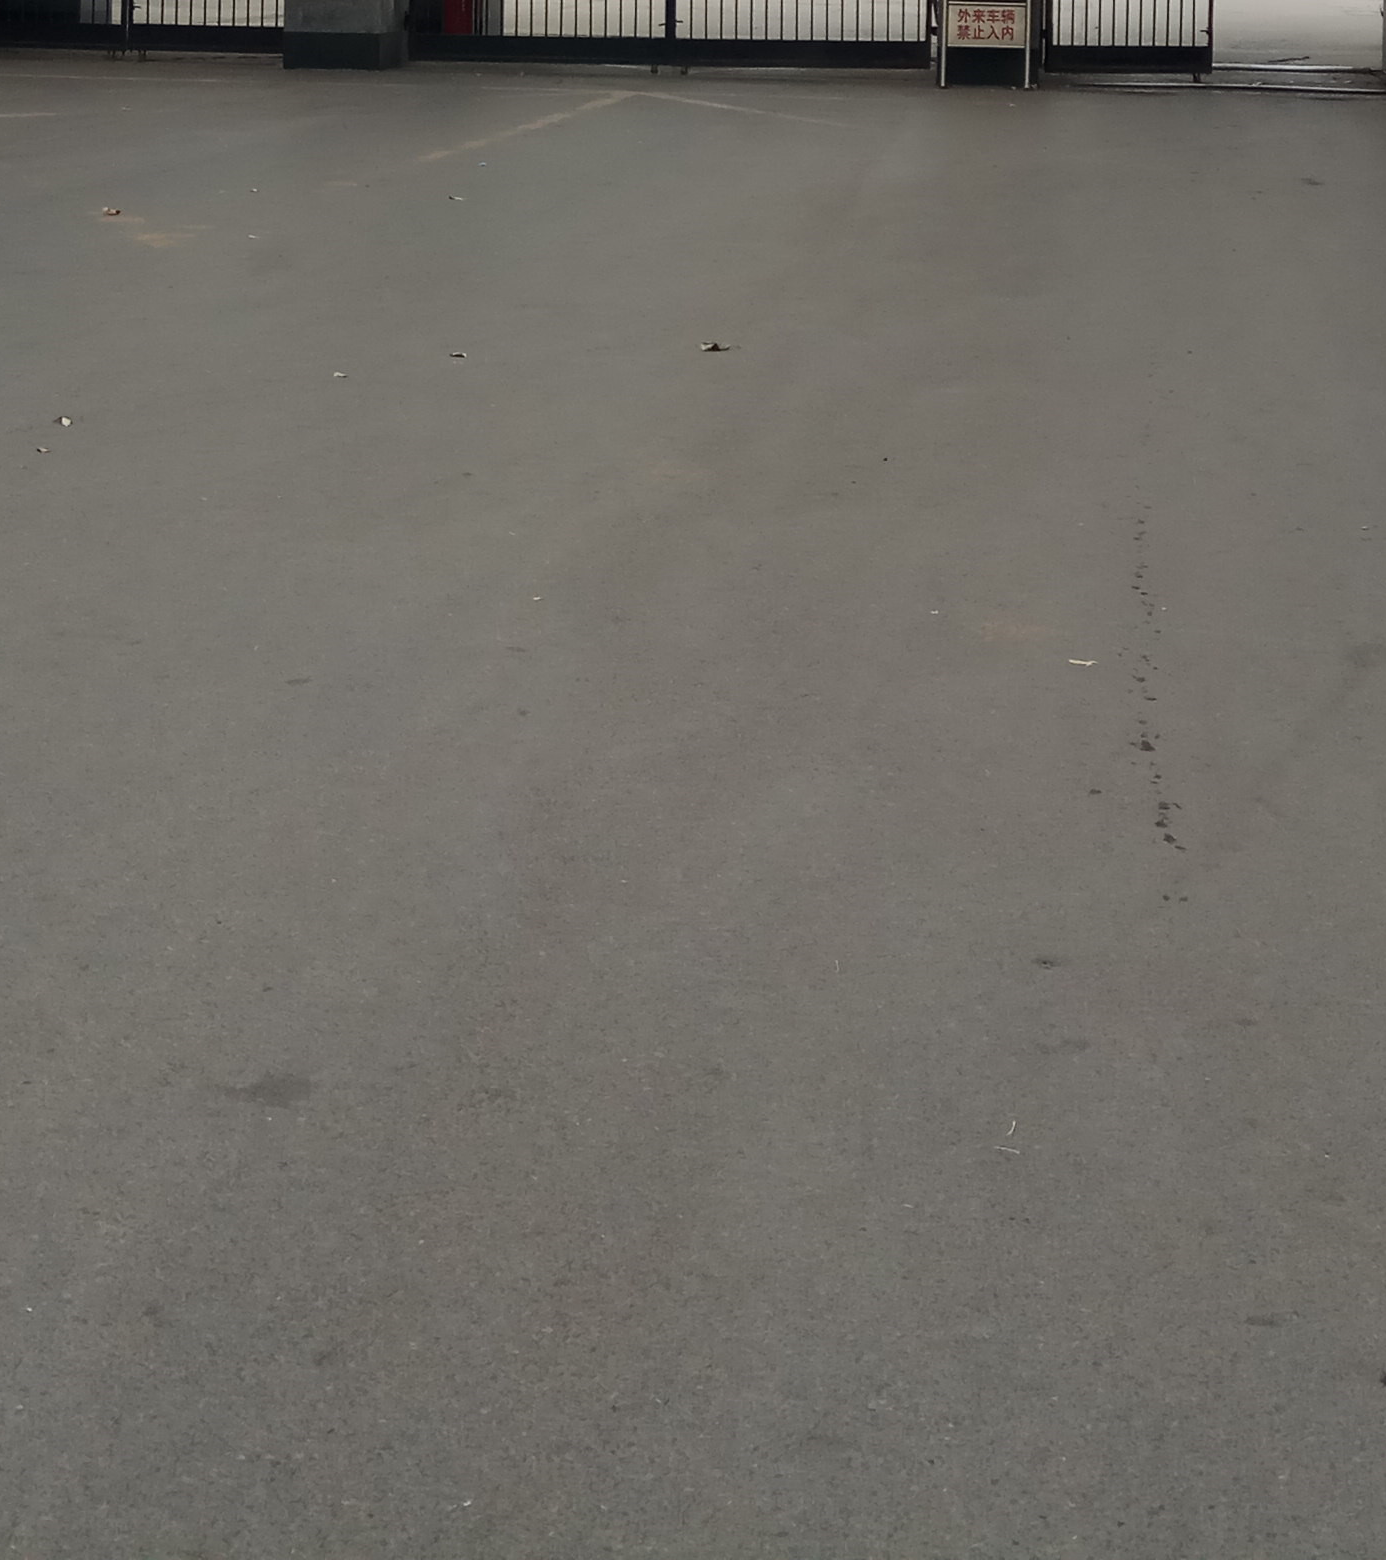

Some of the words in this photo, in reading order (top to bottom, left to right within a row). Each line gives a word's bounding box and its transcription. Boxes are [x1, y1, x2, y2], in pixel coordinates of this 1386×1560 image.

[956, 8, 1016, 24] 外来车辆
[956, 24, 1015, 41] 禁止入内
